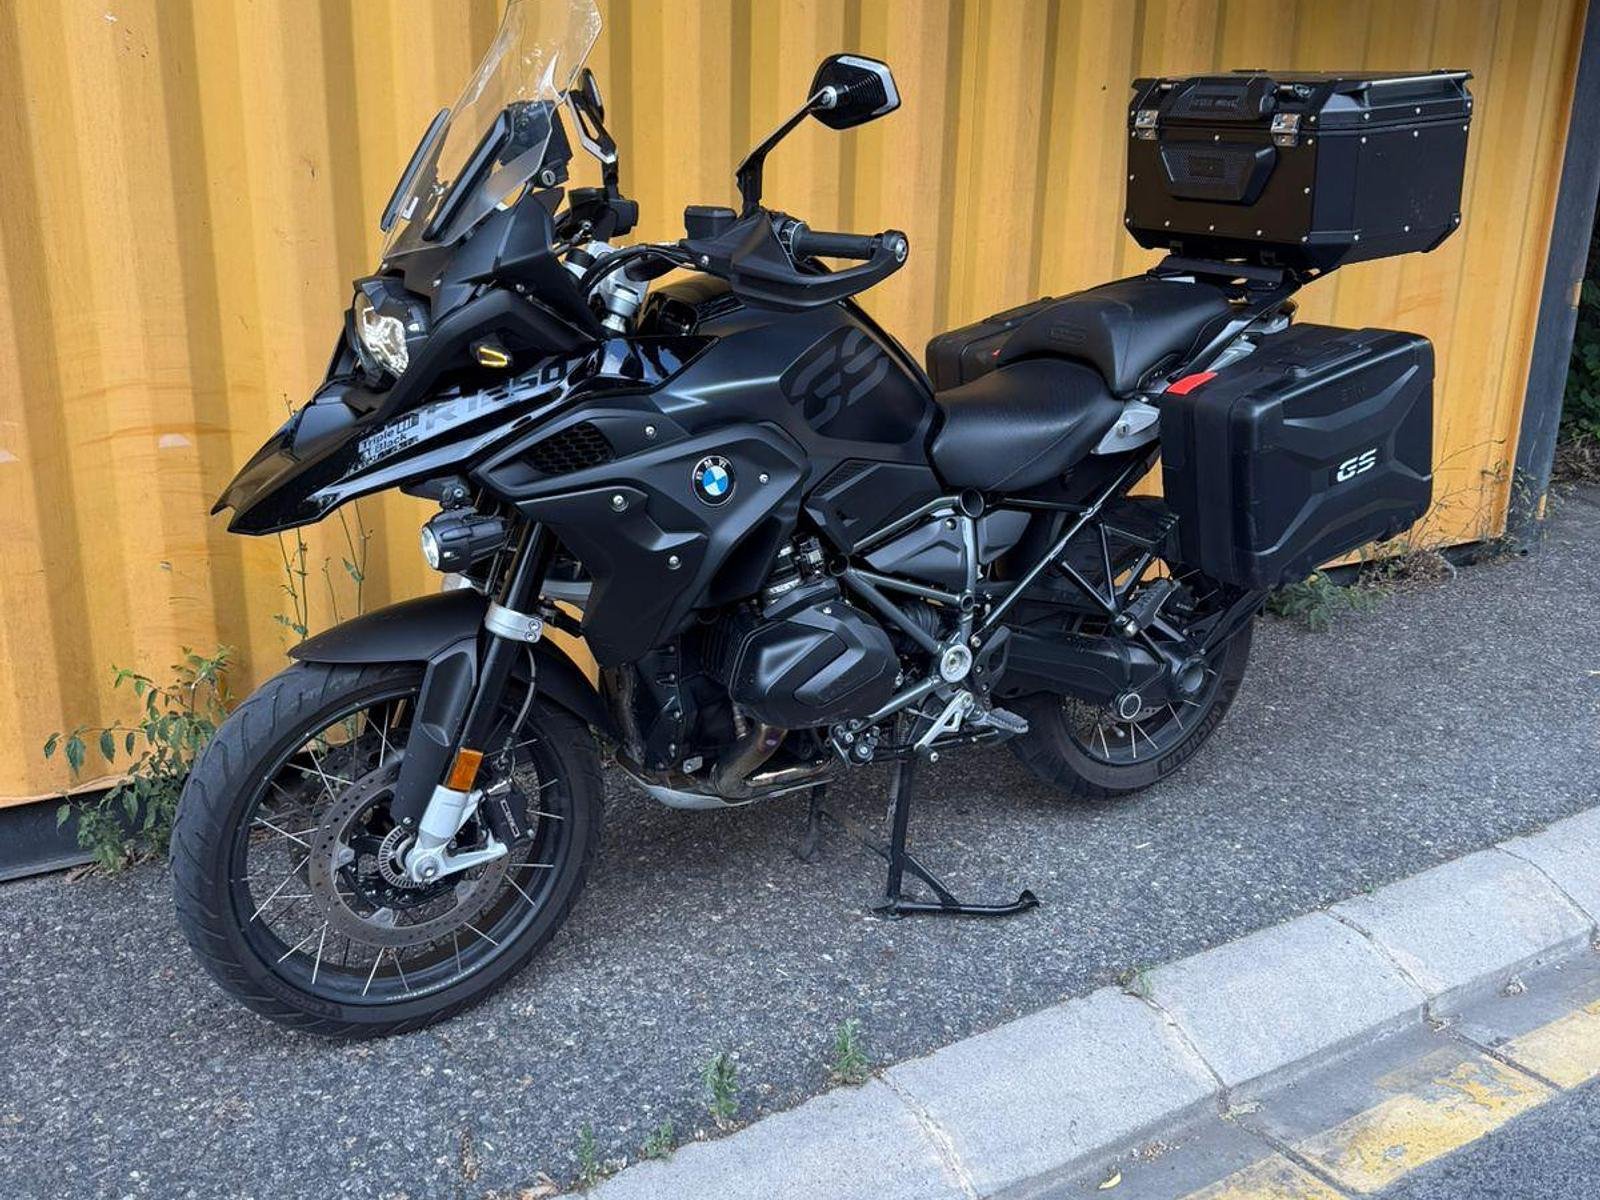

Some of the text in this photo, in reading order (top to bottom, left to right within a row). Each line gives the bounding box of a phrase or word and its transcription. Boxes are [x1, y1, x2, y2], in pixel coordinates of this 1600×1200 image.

[790, 328, 890, 431] GS
[361, 428, 396, 450] Triple
[374, 432, 408, 453] Black
[1337, 448, 1377, 482] GS
